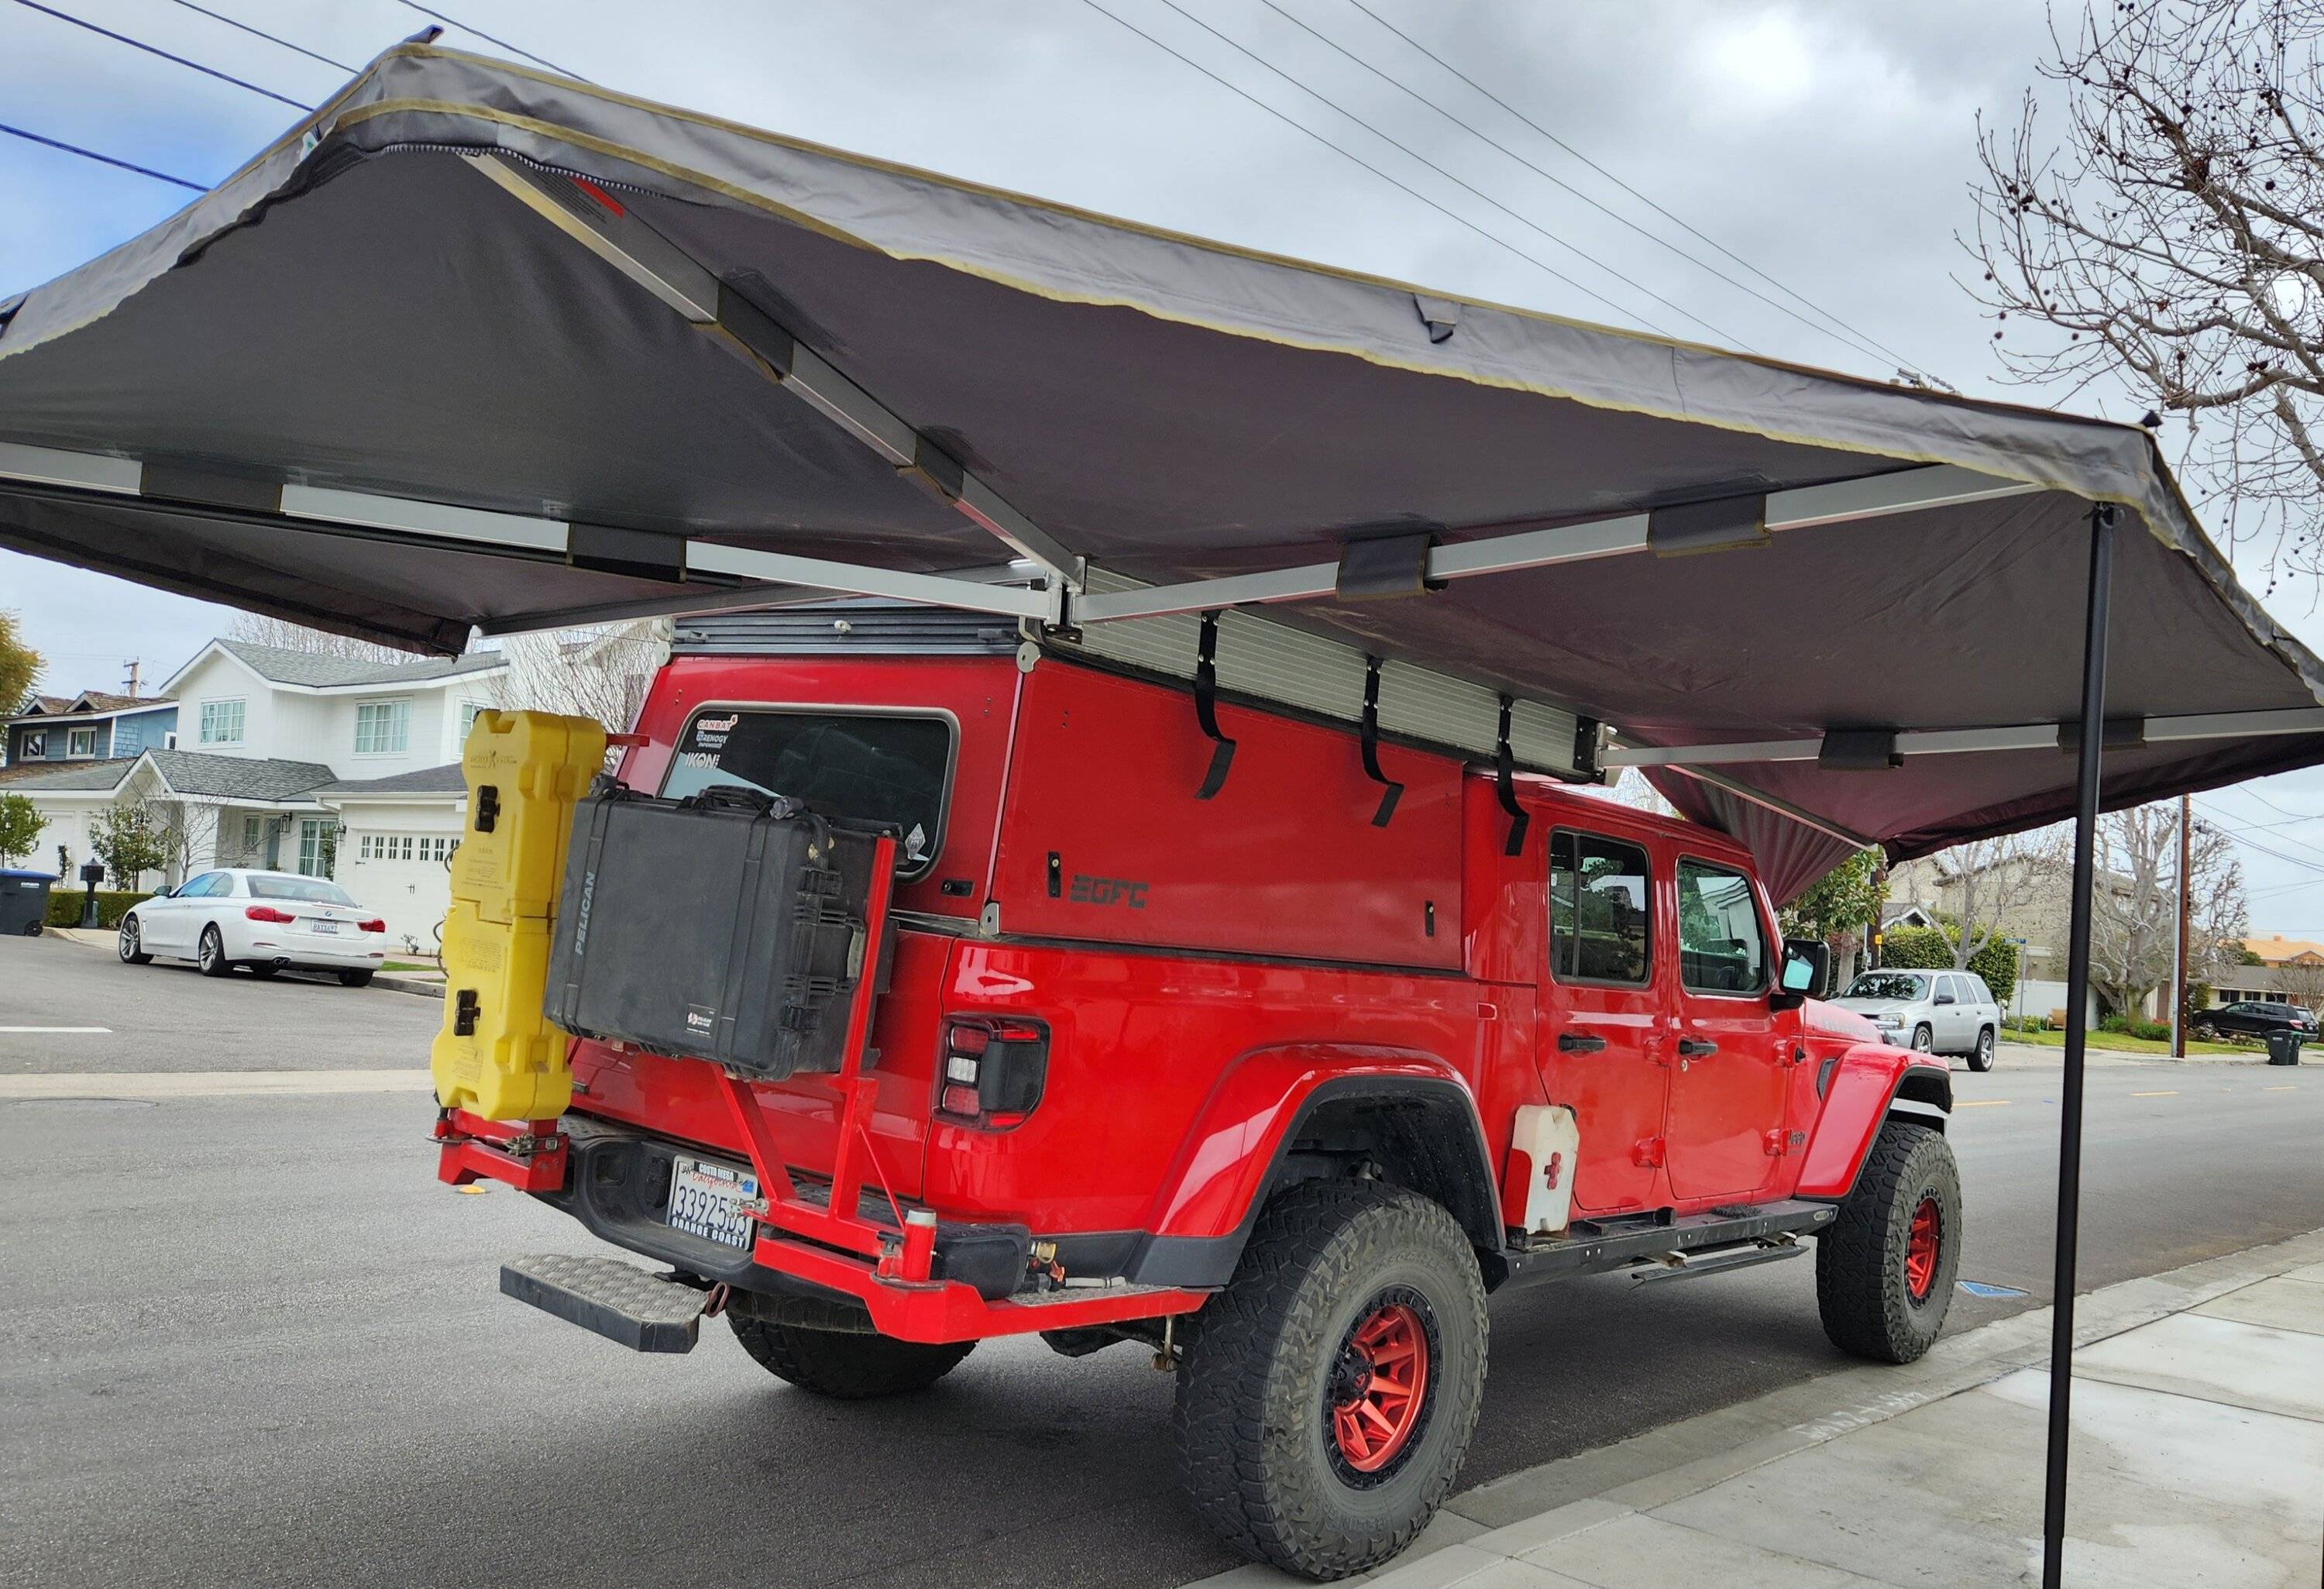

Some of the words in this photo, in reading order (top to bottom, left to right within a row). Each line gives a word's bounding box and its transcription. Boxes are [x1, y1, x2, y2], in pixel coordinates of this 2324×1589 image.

[698, 721, 731, 730] CANBAT
[702, 734, 728, 744] RENOGY
[686, 752, 718, 769] IKON
[575, 871, 595, 956] PELICAN
[698, 1163, 717, 1178] COSTA
[717, 1168, 734, 1181] MESA
[672, 1216, 708, 1237] ORANGE
[711, 1230, 745, 1248] COAST
